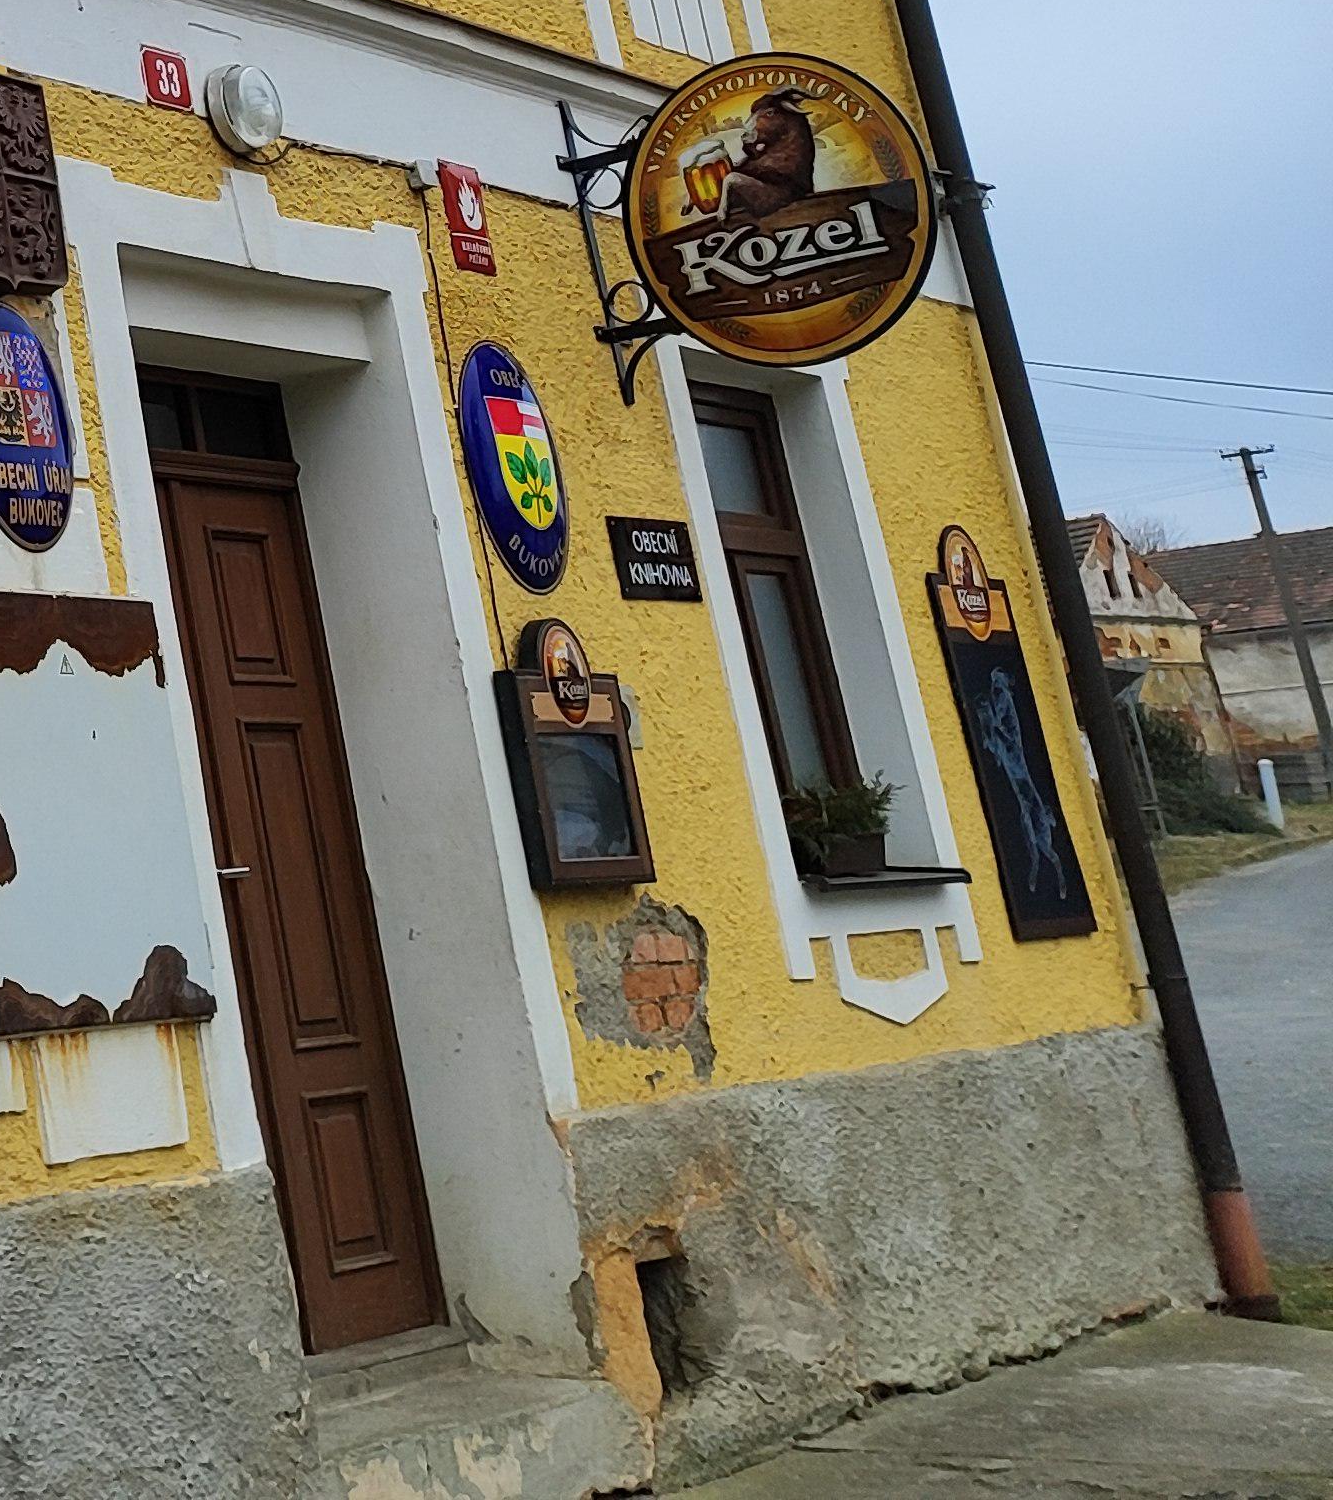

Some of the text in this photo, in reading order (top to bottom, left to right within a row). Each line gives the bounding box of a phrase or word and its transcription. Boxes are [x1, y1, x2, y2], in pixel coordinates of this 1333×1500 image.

[155, 59, 181, 98] 33
[673, 201, 886, 296] Kozel
[763, 280, 823, 305] 1874
[9, 497, 64, 527] BUKOVEC
[632, 528, 679, 555] OBECNÍ
[628, 561, 694, 588] KNIHOVNA
